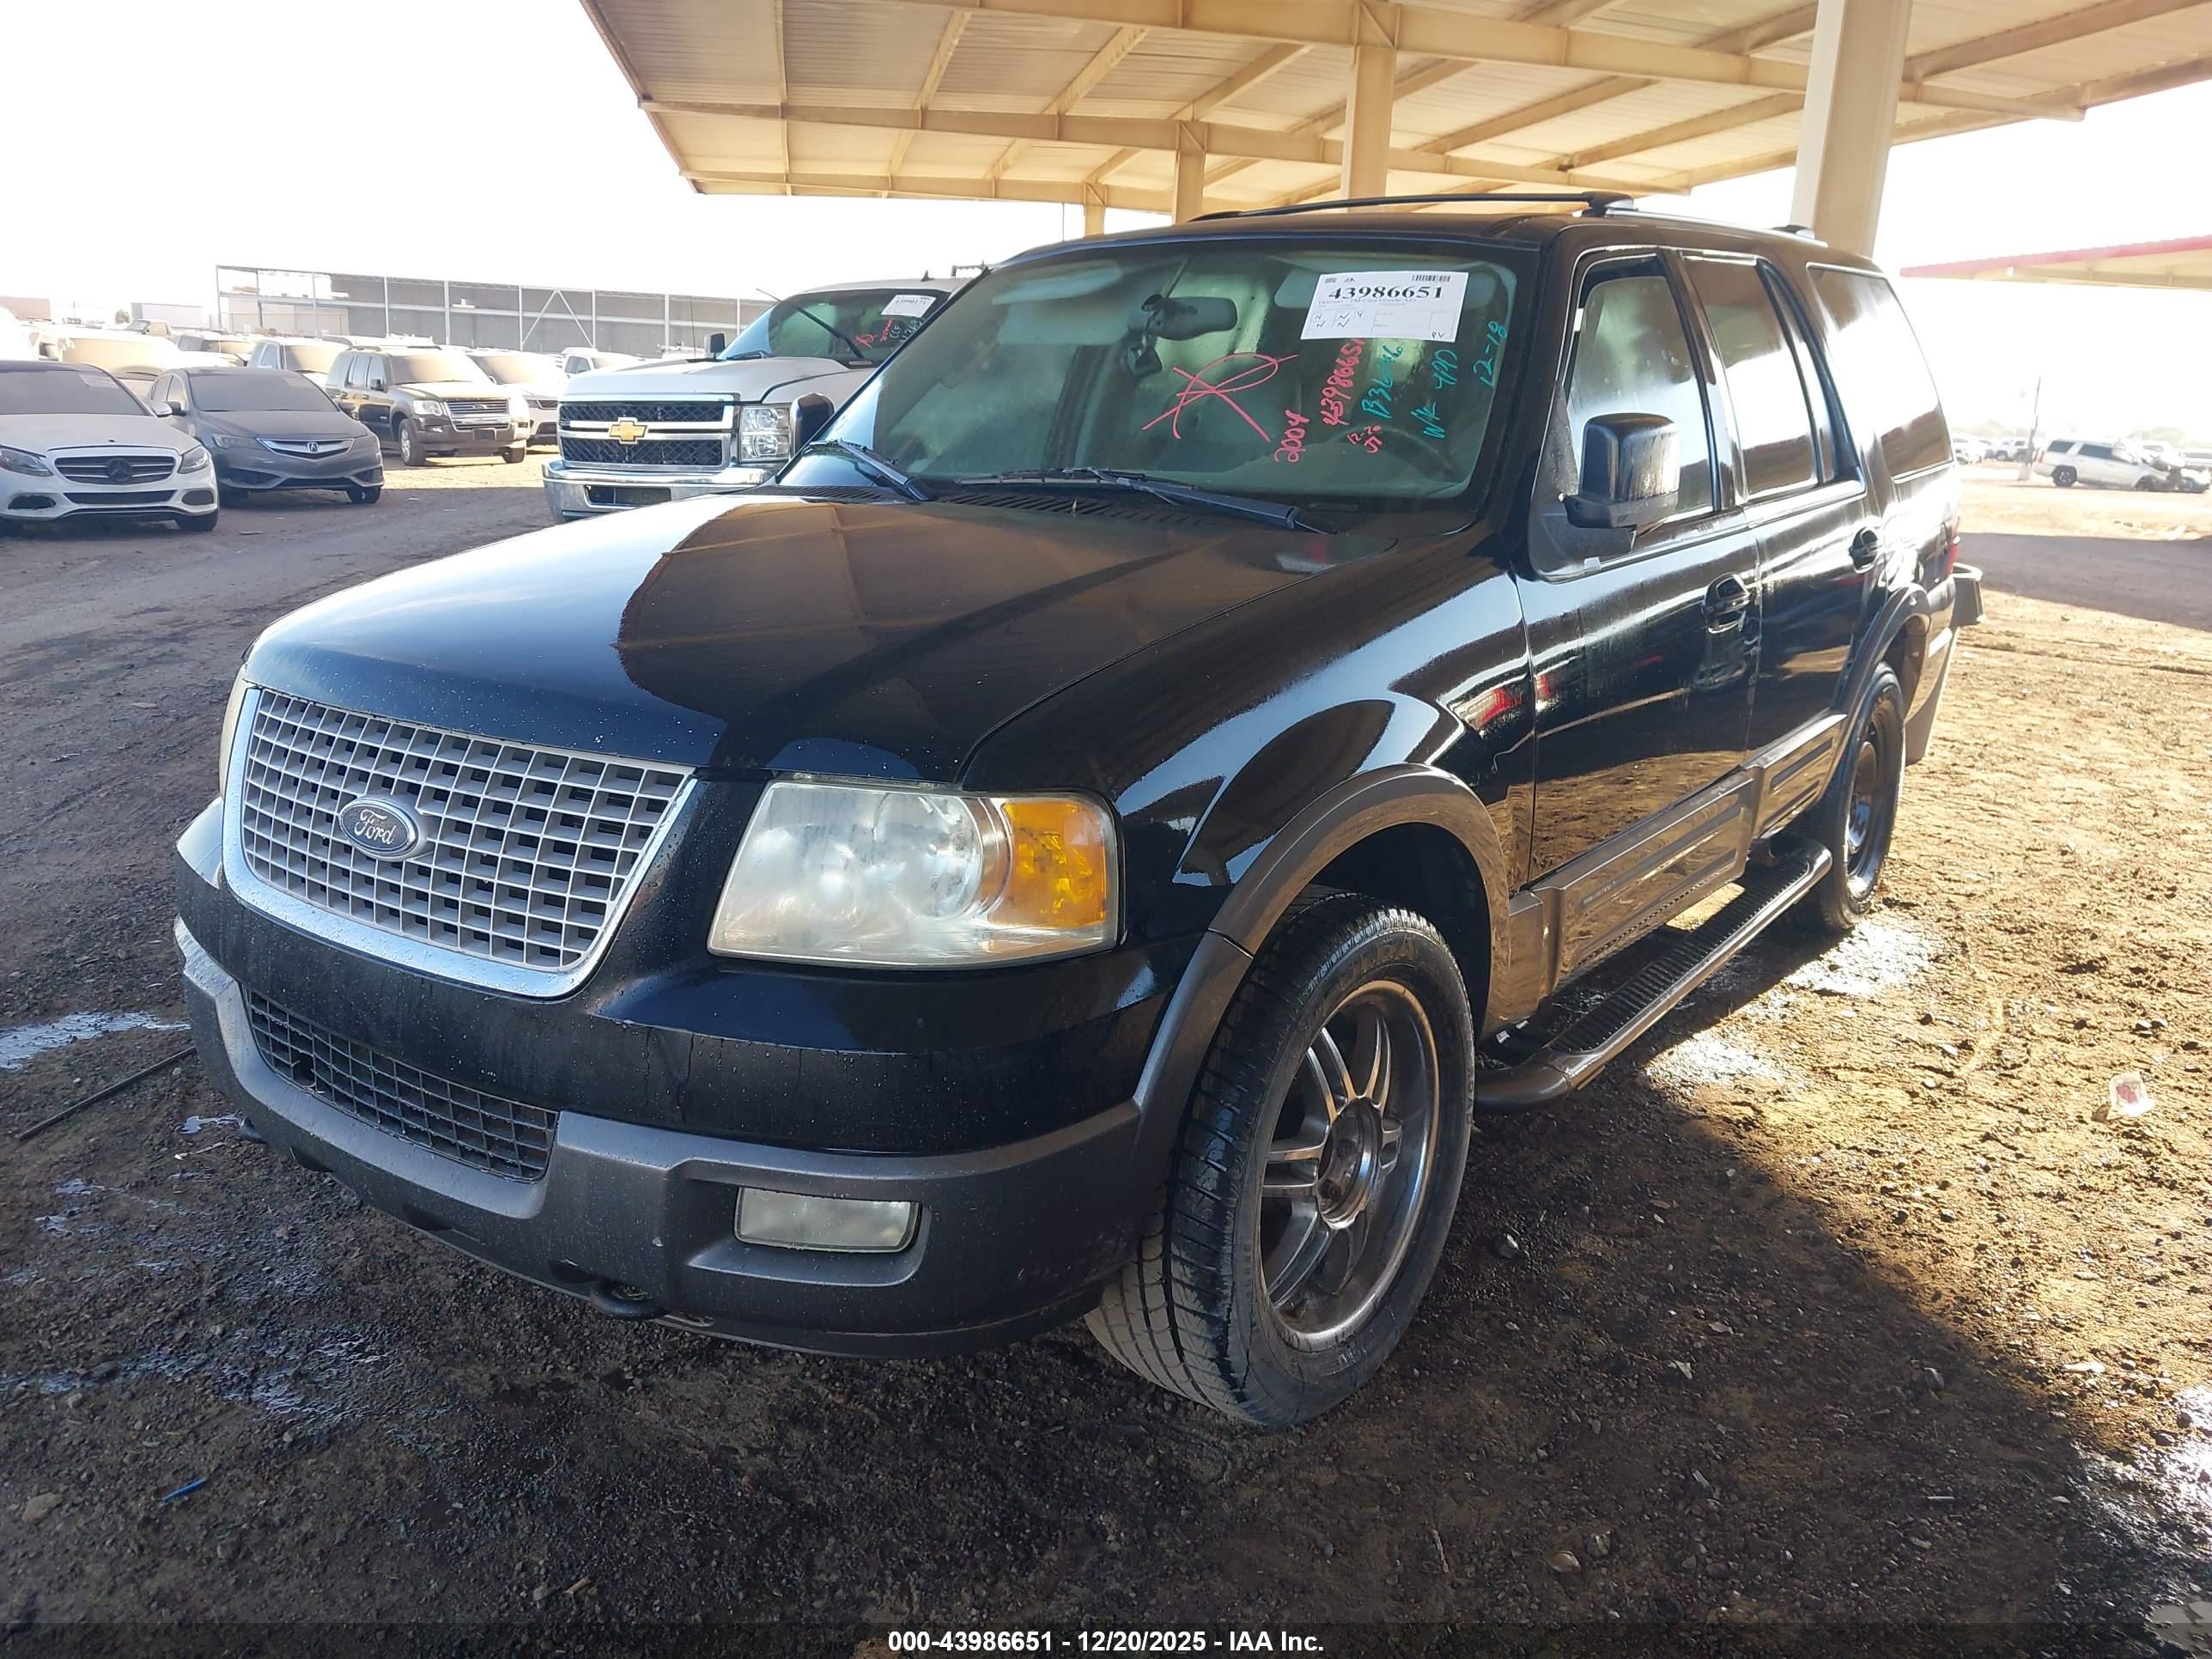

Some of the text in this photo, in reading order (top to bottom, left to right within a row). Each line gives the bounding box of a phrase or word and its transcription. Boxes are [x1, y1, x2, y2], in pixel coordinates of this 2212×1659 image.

[1328, 286, 1442, 300] 43986651
[1274, 410, 1310, 463] 2004
[354, 809, 398, 845] Ford
